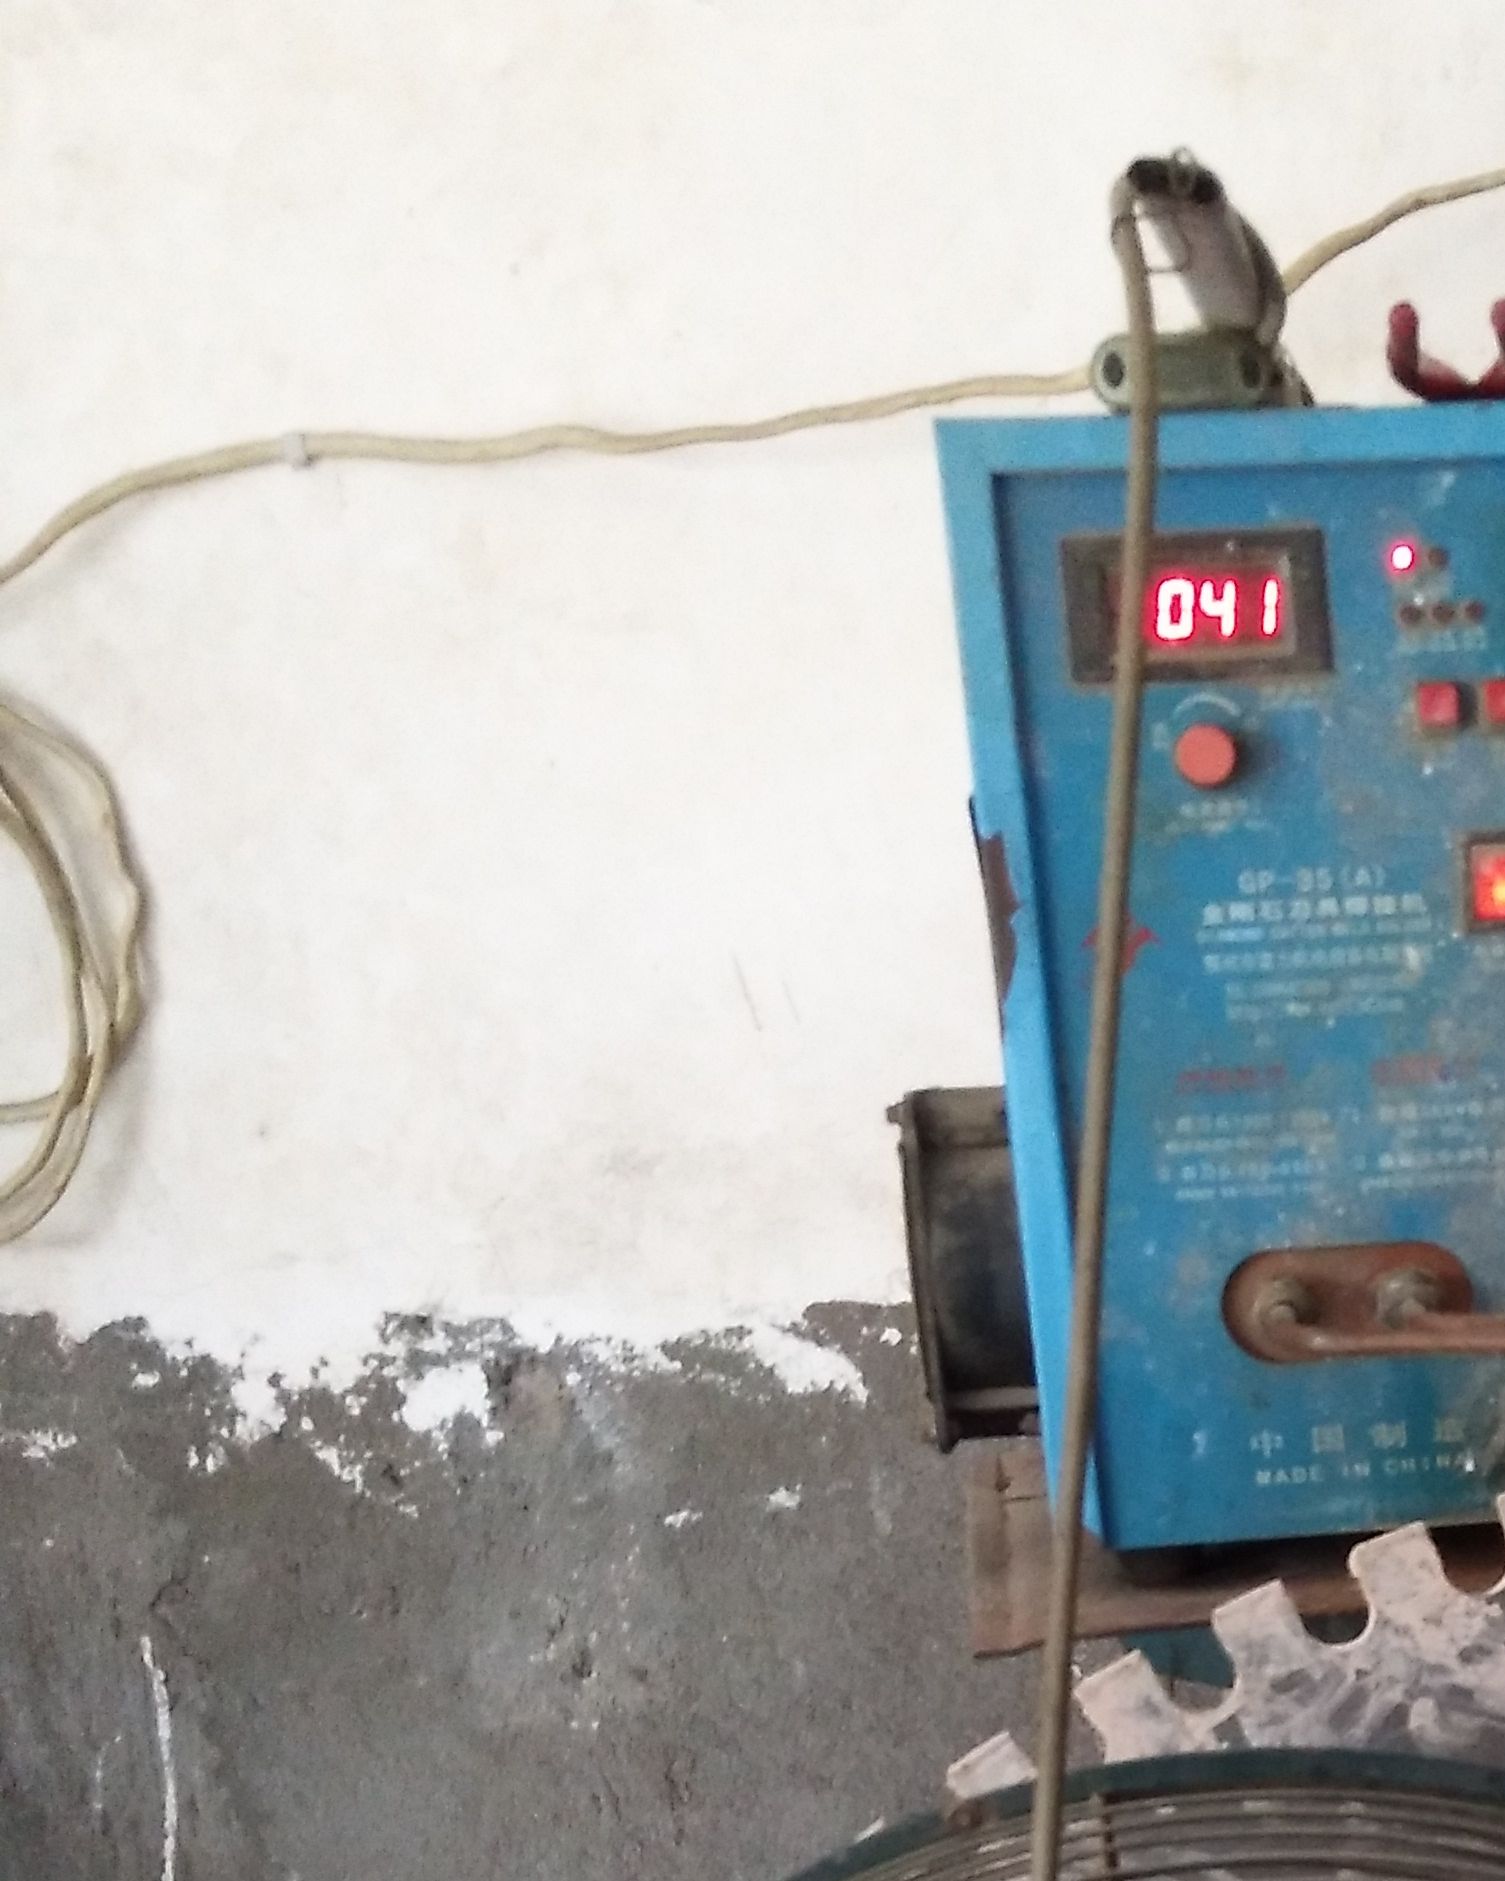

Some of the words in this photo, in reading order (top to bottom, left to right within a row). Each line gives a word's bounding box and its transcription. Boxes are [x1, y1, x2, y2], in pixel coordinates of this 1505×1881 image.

[1155, 577, 1279, 640] 041
[1256, 1464, 1323, 1486] MADE
[1342, 1460, 1370, 1477] IN
